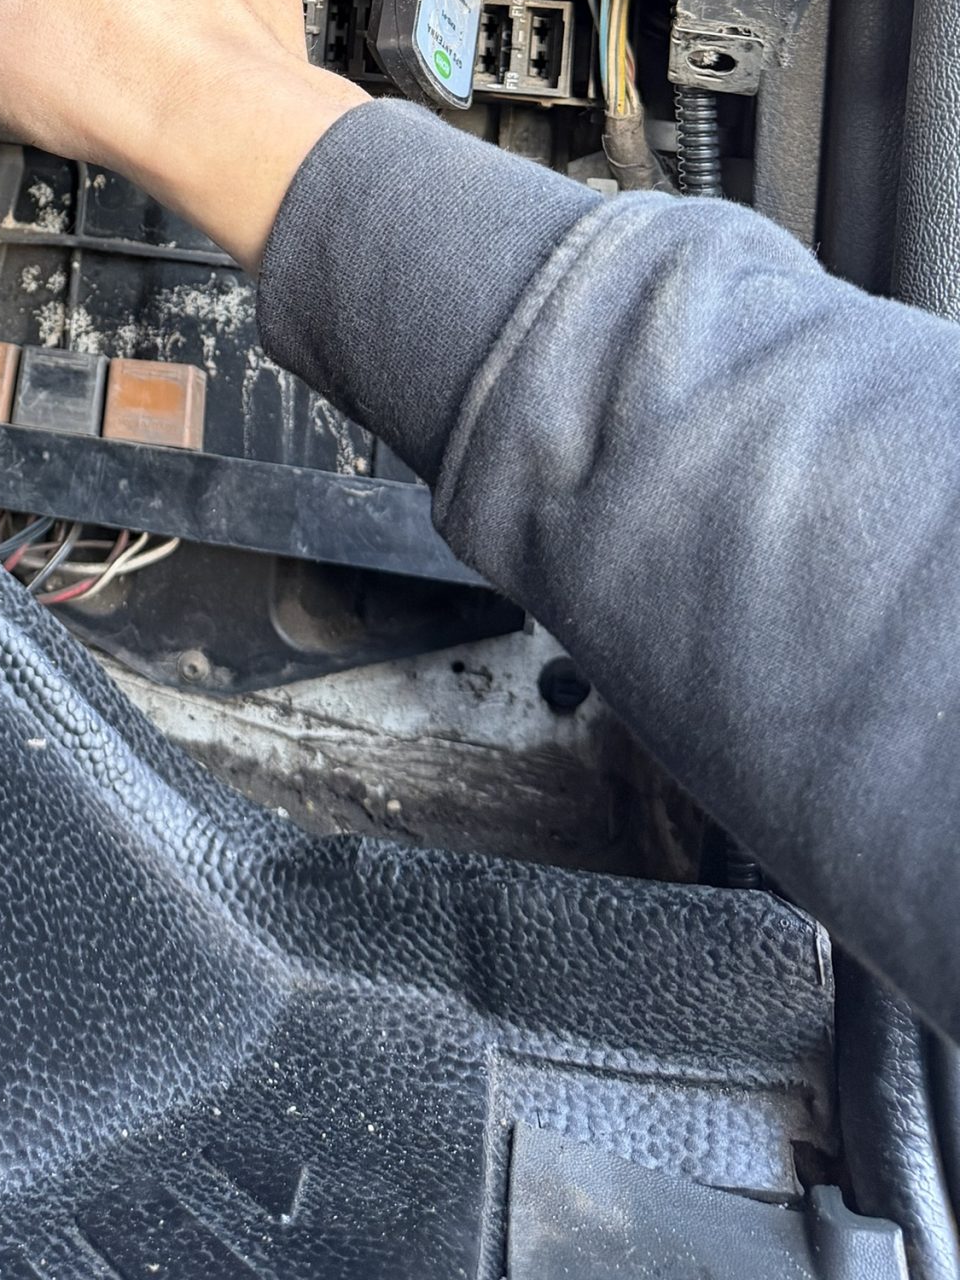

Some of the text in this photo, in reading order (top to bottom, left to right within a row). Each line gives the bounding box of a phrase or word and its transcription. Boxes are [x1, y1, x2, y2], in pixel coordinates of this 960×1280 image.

[512, 0, 524, 17] F14
[427, 23, 453, 57] ANTENNA
[505, 72, 518, 90] F13
